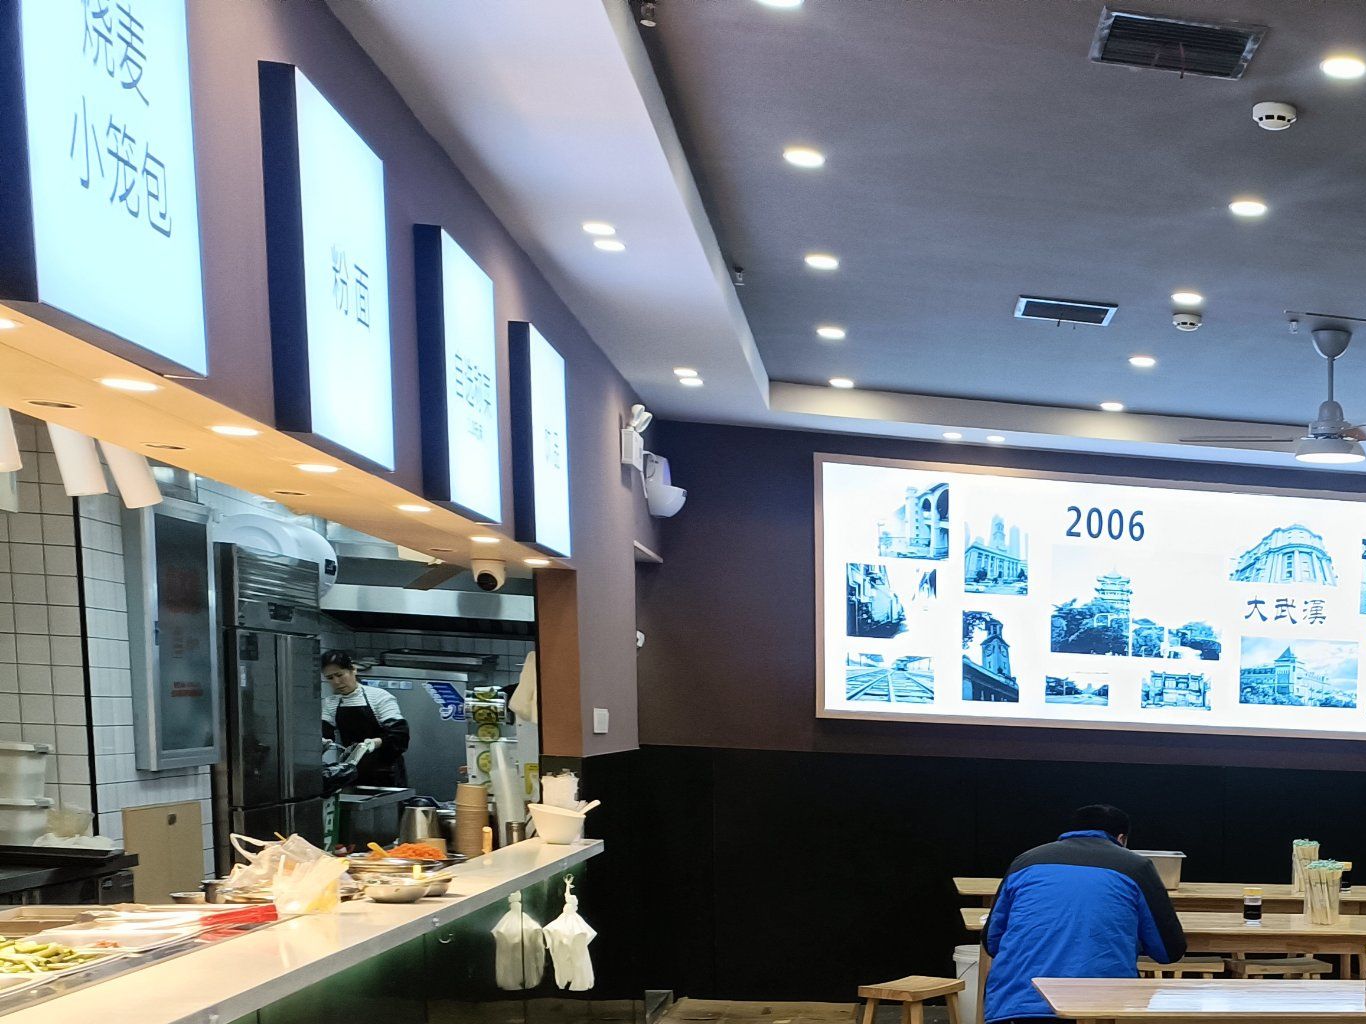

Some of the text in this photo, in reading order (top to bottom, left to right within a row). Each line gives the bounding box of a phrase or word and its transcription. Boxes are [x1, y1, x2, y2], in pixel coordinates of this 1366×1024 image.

[79, 0, 149, 106] 烧麦
[70, 95, 172, 238] 小笼包
[330, 244, 370, 332] 粉面
[1066, 505, 1145, 541] 2006
[1244, 595, 1327, 625] 大武漢
